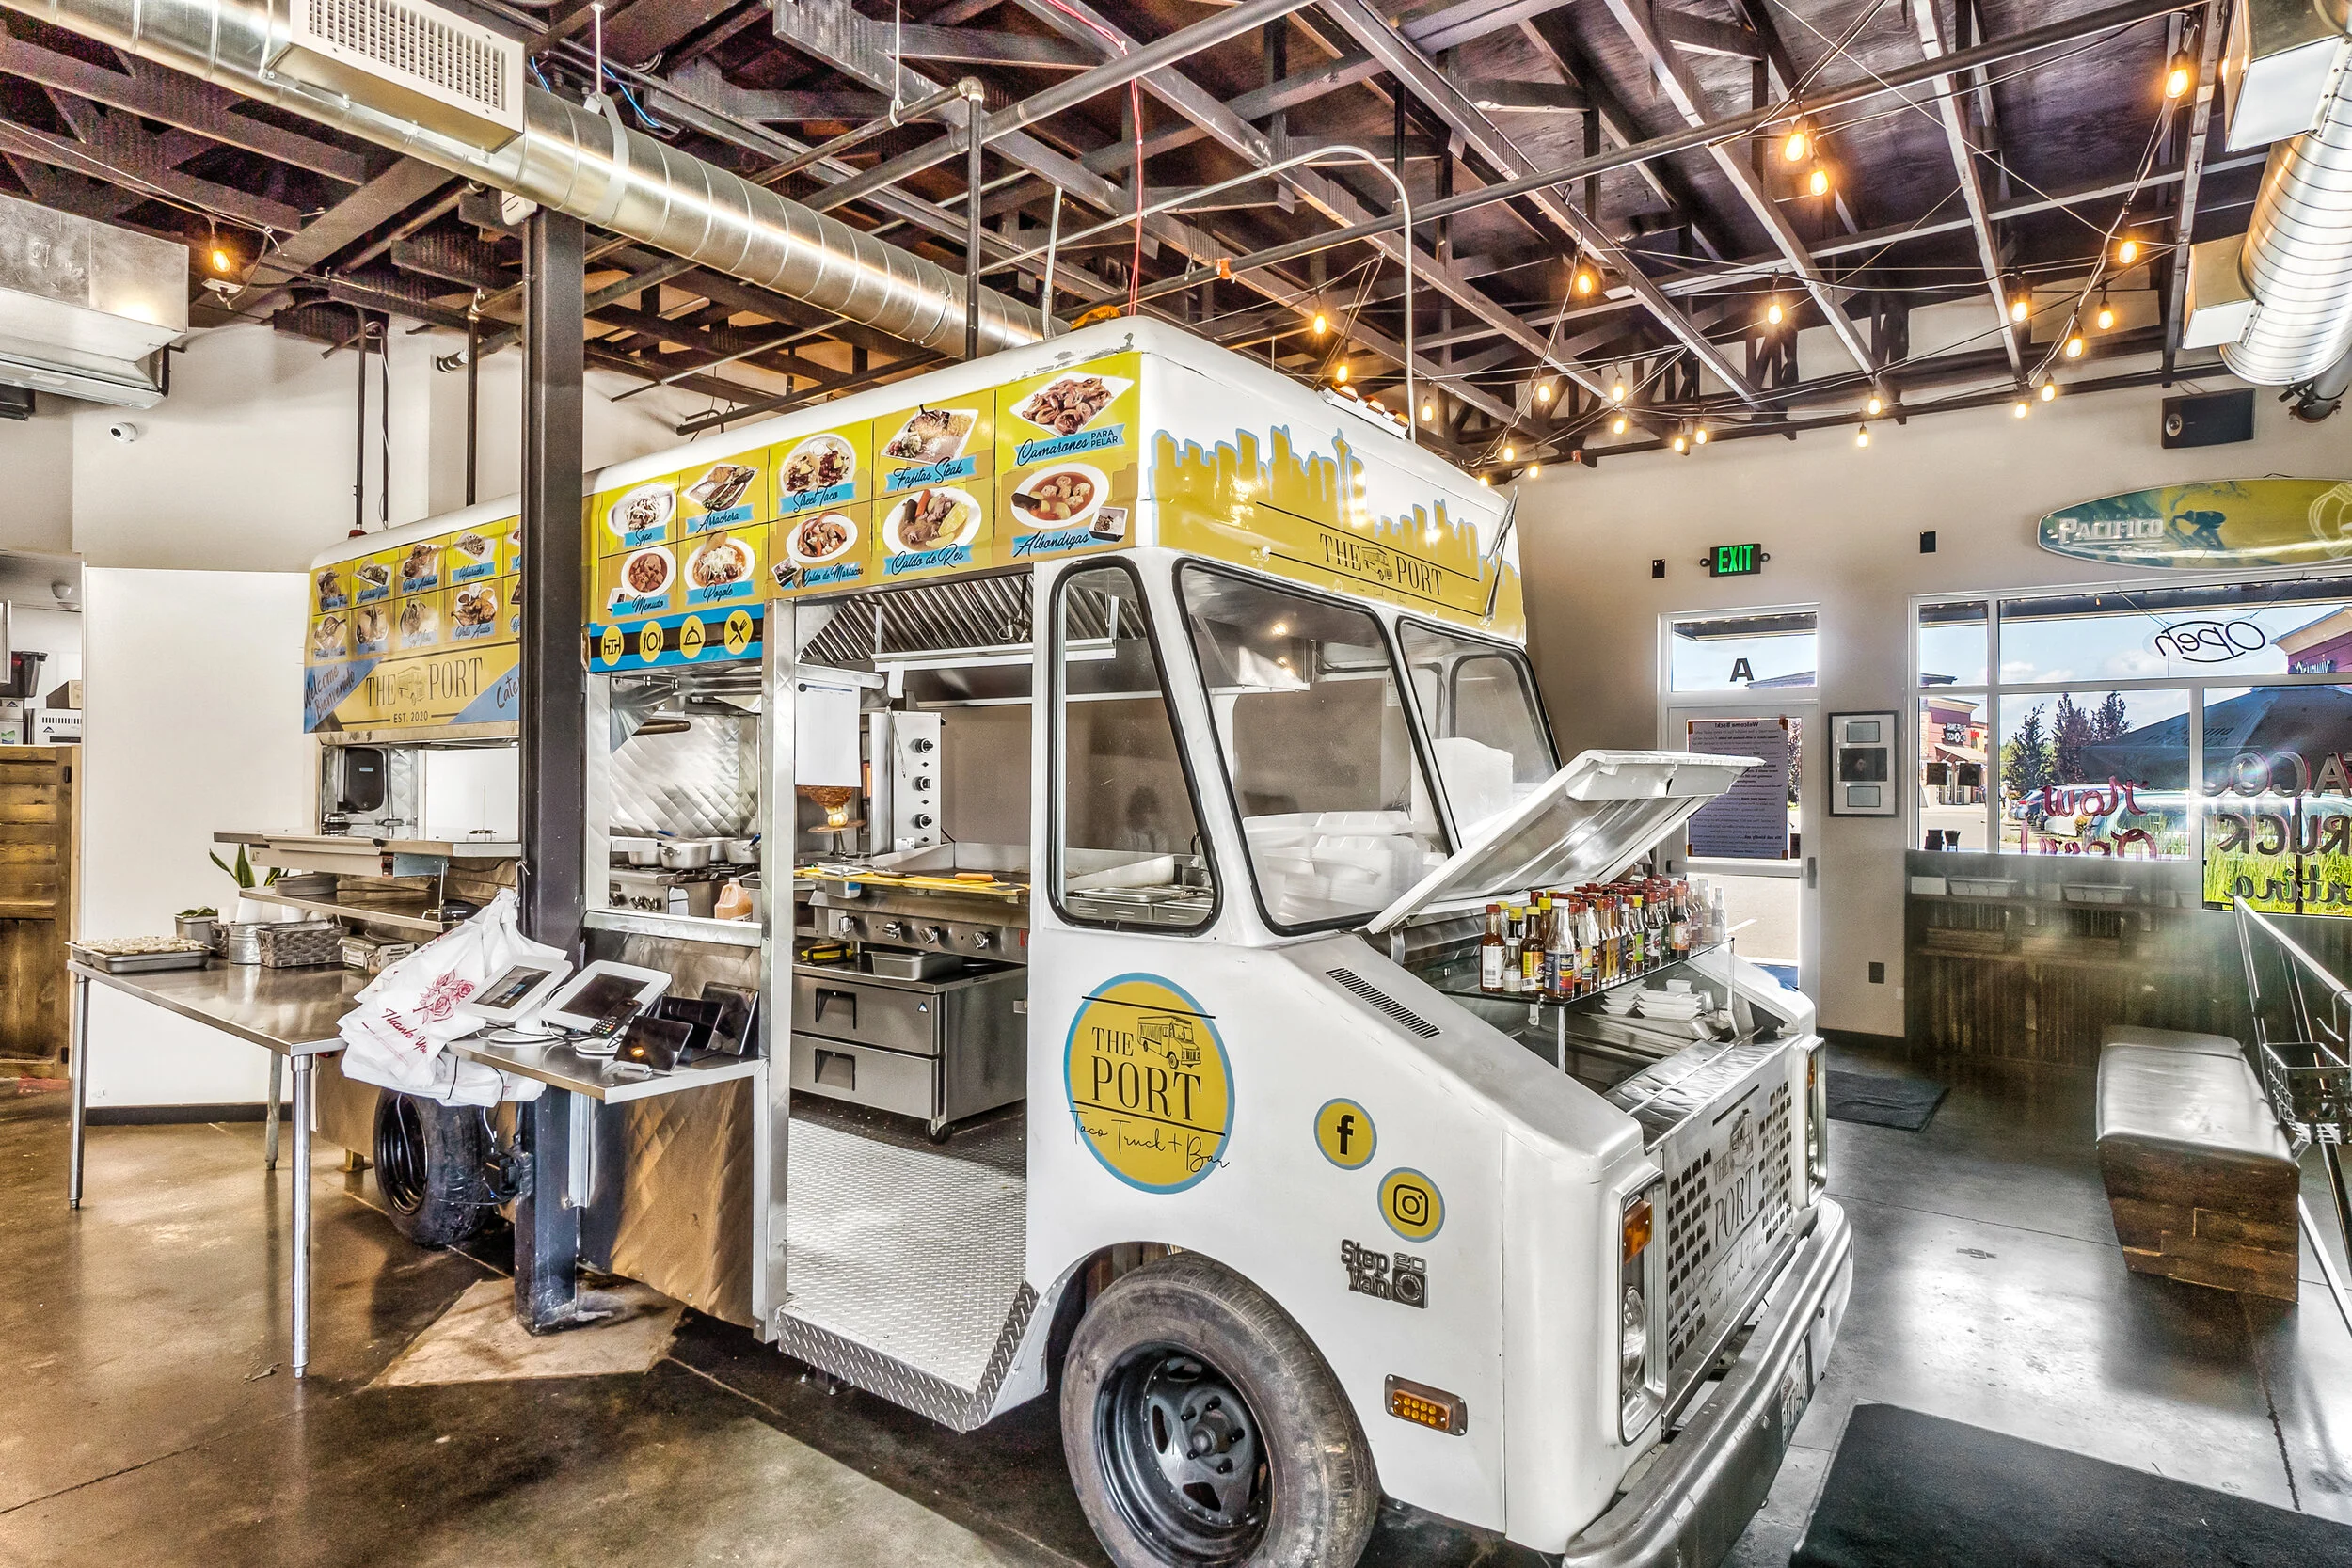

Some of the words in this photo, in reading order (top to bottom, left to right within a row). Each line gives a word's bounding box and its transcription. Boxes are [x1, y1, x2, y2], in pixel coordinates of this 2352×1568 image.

[1090, 429, 1114, 440] PARA
[1090, 436, 1119, 448] PELAR
[1017, 438, 1089, 467] Camarones
[893, 467, 931, 491] Fajitas
[817, 483, 838, 507] Taco
[696, 511, 740, 534] Arrachera
[2058, 517, 2164, 545] PACIFICO
[1013, 529, 1089, 558] Albondigas
[891, 550, 923, 576] Caldo
[925, 552, 936, 564] de
[937, 543, 964, 569] Res
[1320, 533, 1362, 572] THE
[1395, 555, 1443, 596] PORT
[1718, 545, 1754, 573] EXIT
[632, 594, 664, 615] Menudo
[703, 581, 734, 603] Pozole
[365, 673, 397, 707] THE
[429, 657, 483, 700] PORT
[1729, 657, 1755, 682] A
[304, 665, 339, 709] Welcome
[496, 676, 520, 709] Cate
[393, 712, 408, 724] EST.
[411, 710, 429, 722] 2020
[381, 1008, 418, 1039] Thank
[1091, 1026, 1135, 1057] THE
[1090, 1055, 1201, 1122] PORT
[1069, 1110, 1109, 1145] Taco
[1111, 1119, 1166, 1155] Truck
[1185, 1133, 1231, 1173] Bar
[1713, 1150, 1730, 1186] THE
[1714, 1164, 1755, 1249] PORT
[1340, 1238, 1391, 1279] Step
[1393, 1252, 1428, 1275] 20
[1346, 1263, 1392, 1301] Van
